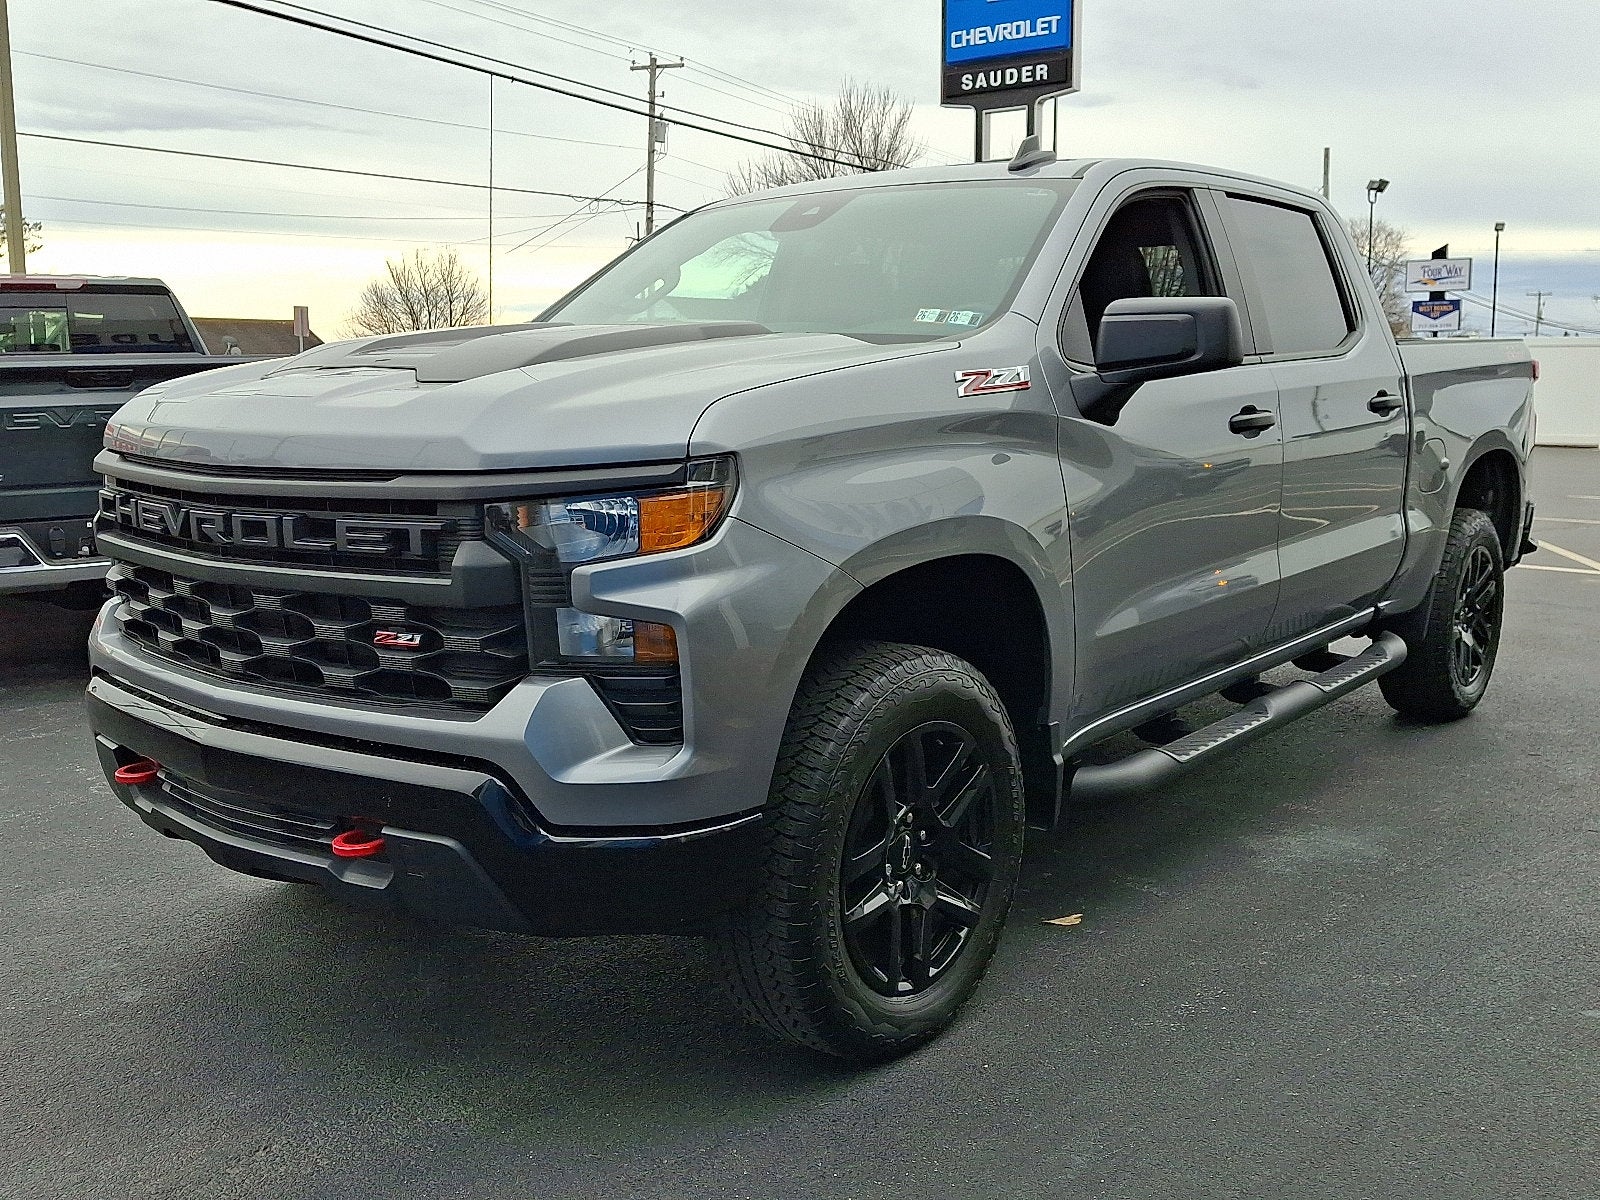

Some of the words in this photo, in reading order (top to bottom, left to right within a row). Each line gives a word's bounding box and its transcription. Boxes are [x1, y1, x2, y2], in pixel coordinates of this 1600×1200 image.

[951, 15, 1061, 49] CHEVROLET
[961, 63, 1049, 91] SAUDER
[954, 365, 1031, 398] Z71
[99, 489, 456, 557] CHEVROLET
[373, 630, 422, 647] Z71
